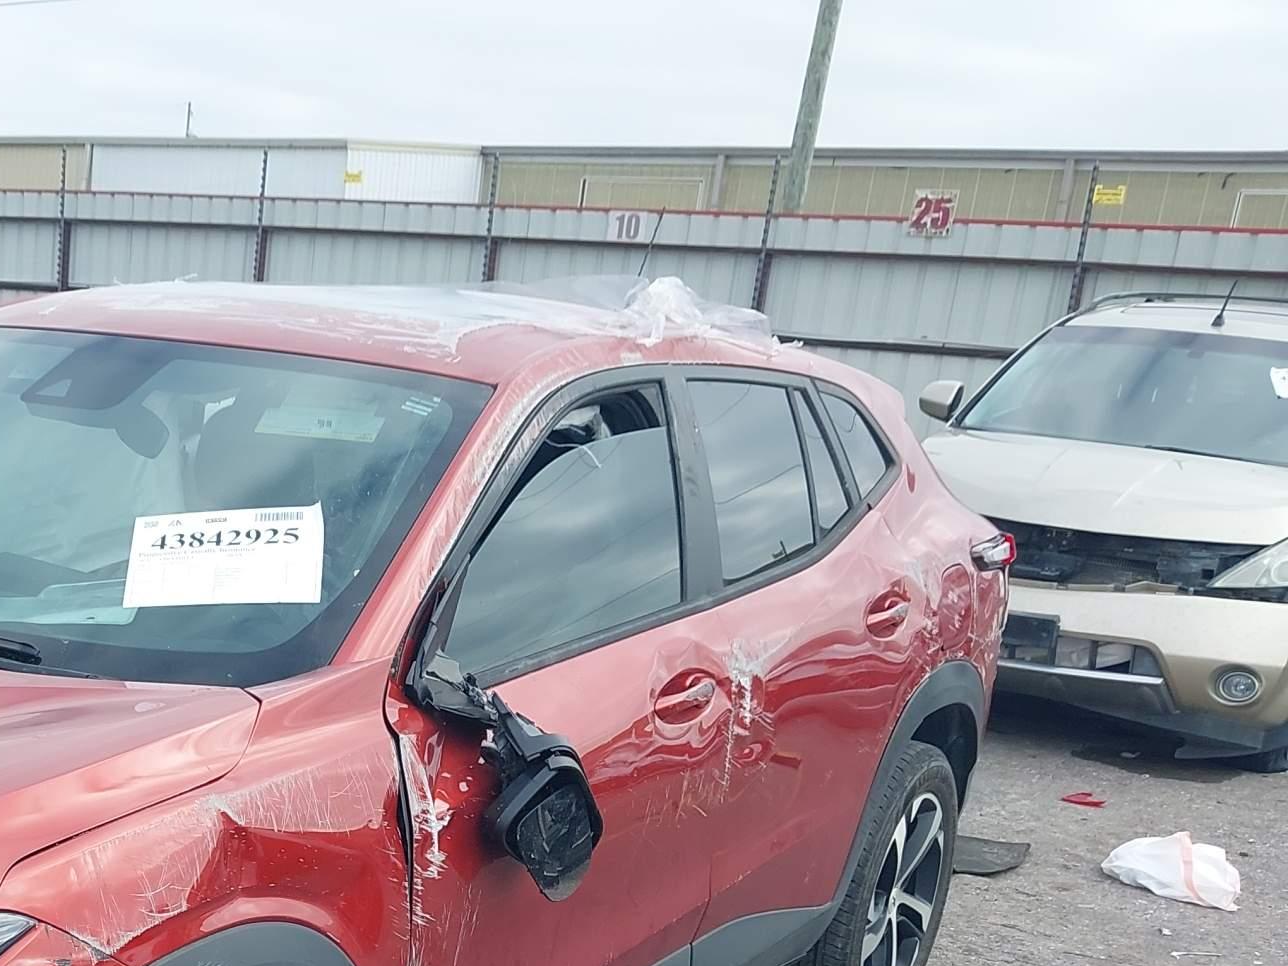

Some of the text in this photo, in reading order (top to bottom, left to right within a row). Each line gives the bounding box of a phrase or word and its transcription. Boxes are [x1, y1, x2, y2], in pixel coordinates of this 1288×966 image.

[615, 213, 640, 240] 10
[910, 196, 953, 231] 25
[151, 528, 300, 550] 43842925
